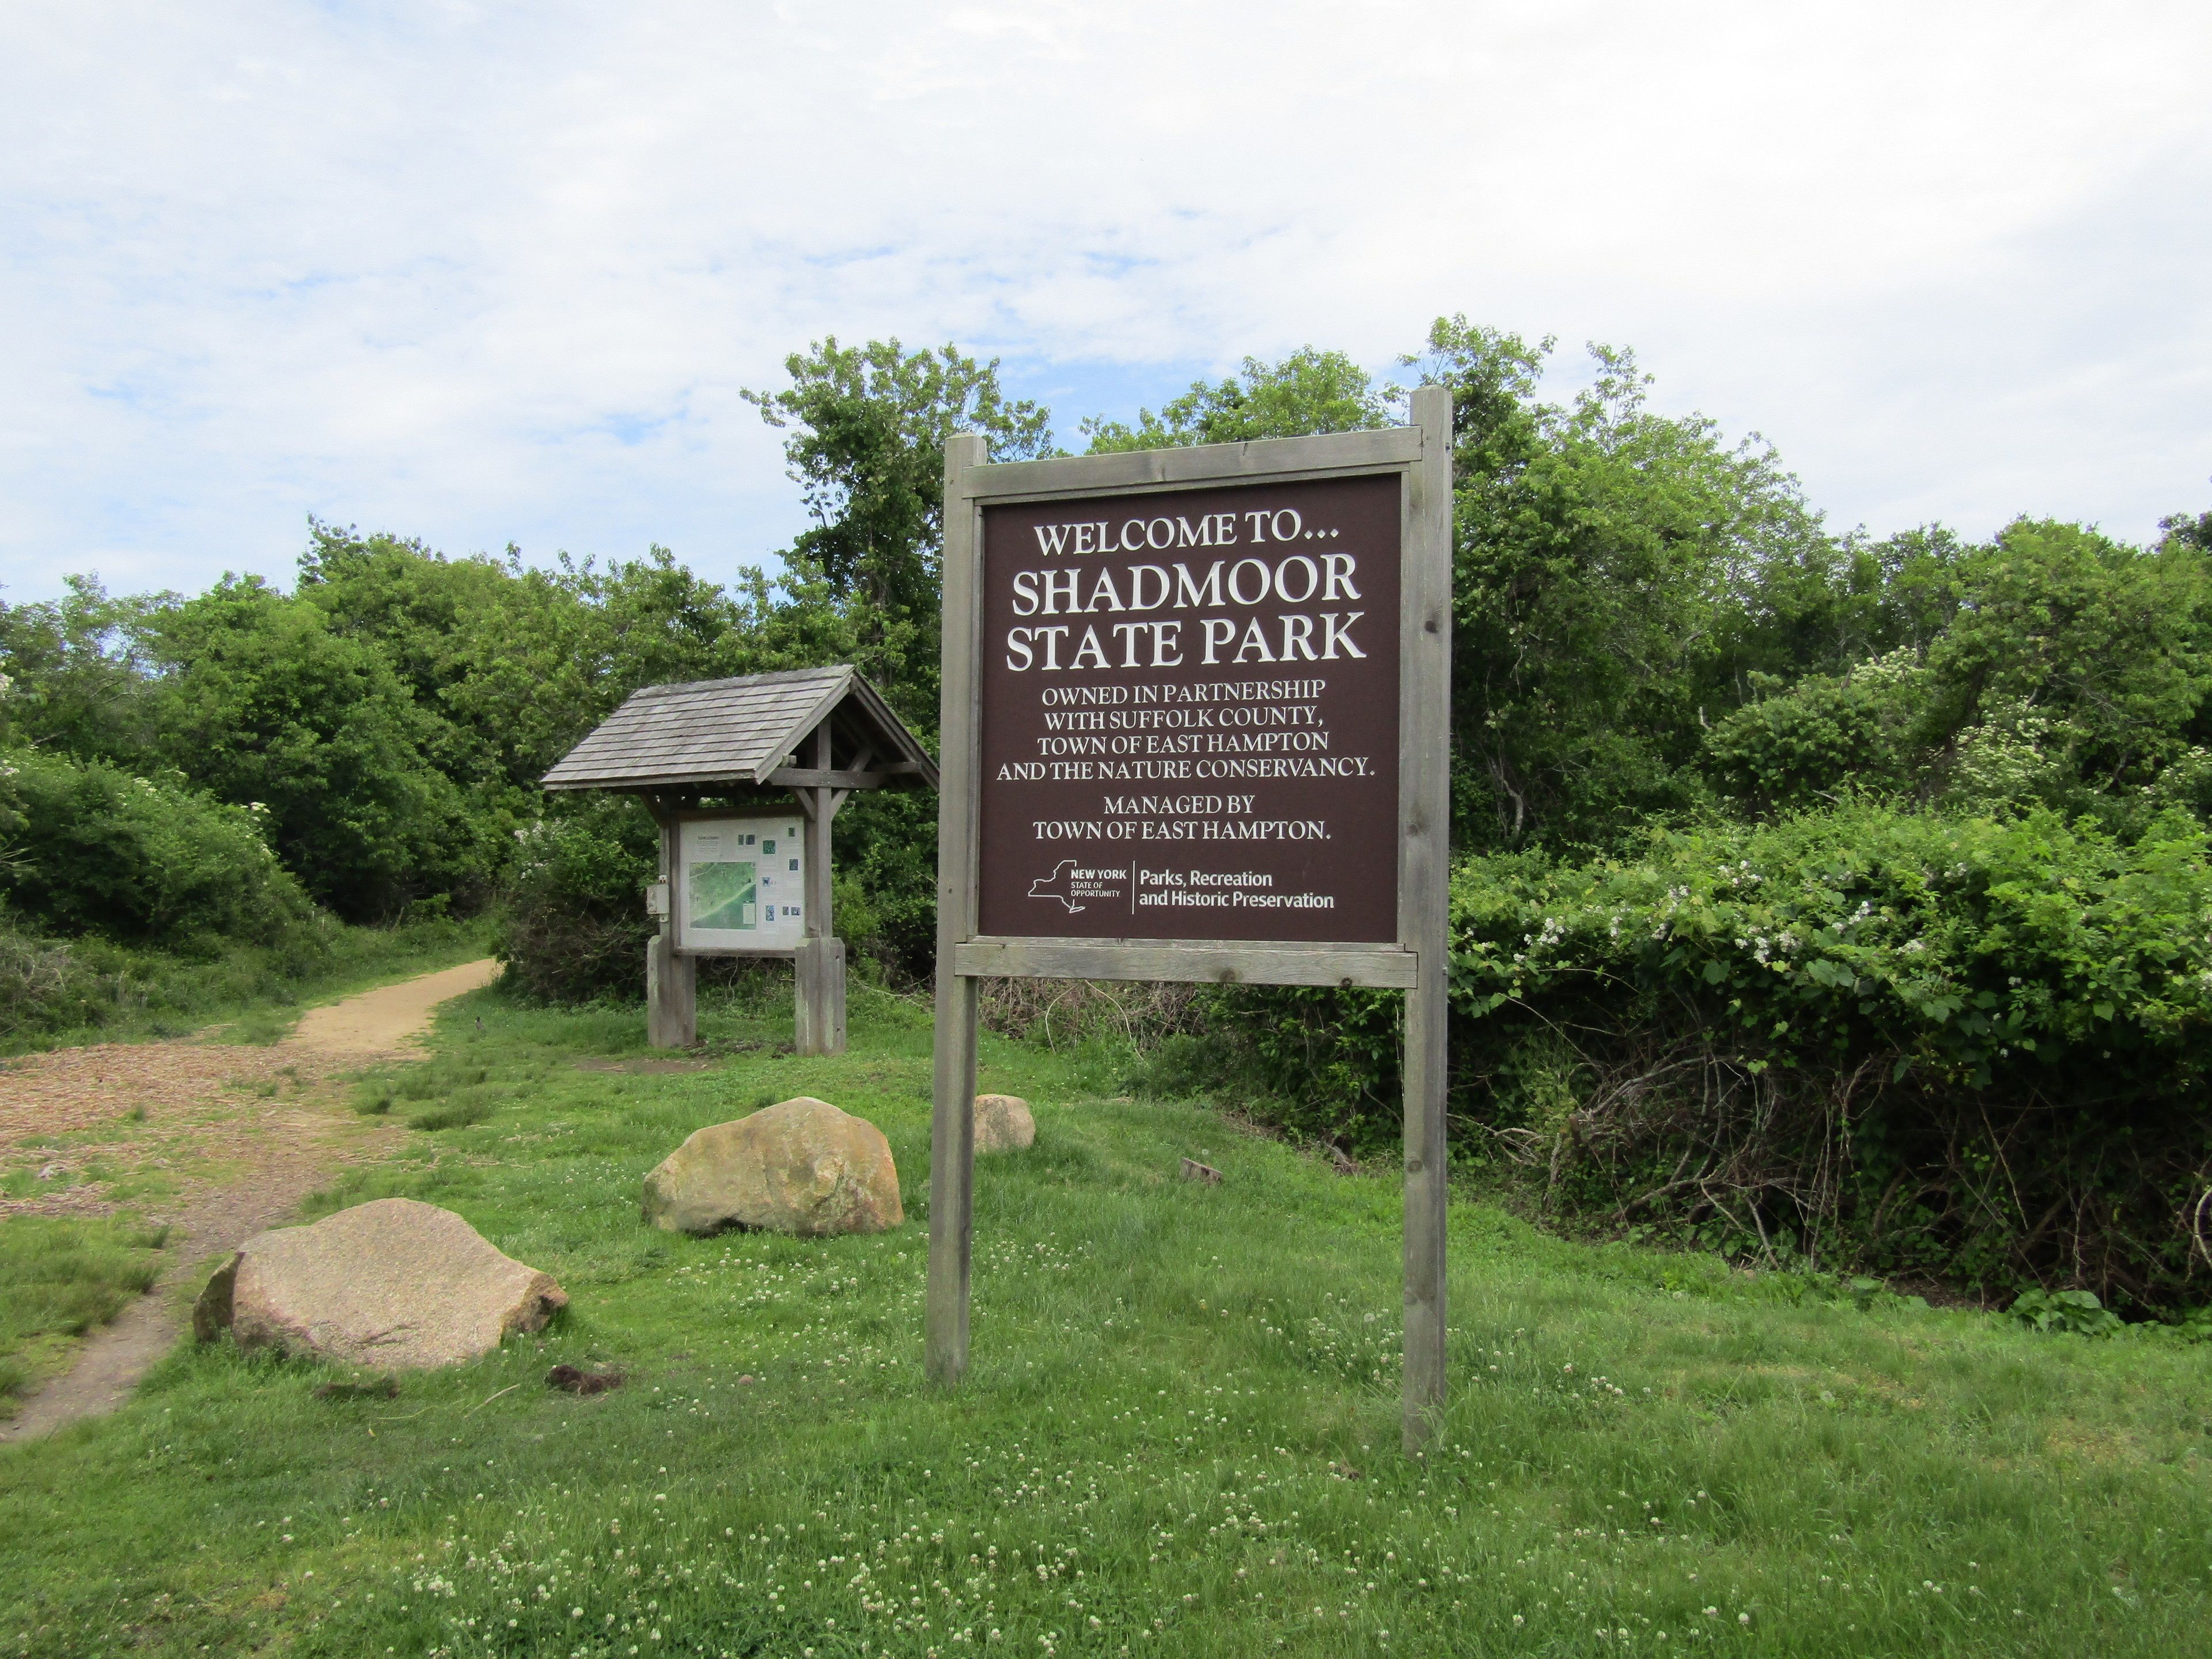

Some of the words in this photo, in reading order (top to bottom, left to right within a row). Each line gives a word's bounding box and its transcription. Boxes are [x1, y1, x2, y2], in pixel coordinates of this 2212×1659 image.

[1033, 513, 1237, 556] WELCOME
[1244, 508, 1339, 543] TO...
[1012, 553, 1362, 616] SHADMOOR
[1006, 620, 1183, 672] STATE
[1199, 611, 1368, 665] PARK
[1041, 686, 1128, 706] OWNED
[1132, 684, 1158, 704] IN
[1162, 679, 1326, 703] PARTNERSHIP
[1044, 711, 1106, 731] WITH
[1109, 708, 1214, 729] SUFFOLK
[1218, 705, 1323, 728] COUNTY,
[1037, 736, 1107, 755] TOWN
[1111, 736, 1142, 755] OF
[1146, 734, 1203, 754] EAST
[1206, 731, 1330, 752] HAMPTON
[996, 762, 1046, 781] AND
[1049, 761, 1094, 780] THE
[1097, 760, 1192, 779] NATURE
[1196, 756, 1376, 778] CONSERVANCY.
[1103, 795, 1222, 815] MANAGED
[1226, 794, 1256, 814] BY
[1032, 821, 1103, 839] TOWN
[1107, 821, 1138, 839] OF
[1141, 820, 1199, 840] EAST
[1202, 820, 1331, 840] HAMPTON.
[1070, 869, 1096, 880] NEW
[1096, 869, 1127, 880] YORK
[1071, 881, 1092, 889] STATE
[1140, 869, 1187, 888] Parks,
[1190, 869, 1272, 887] Recreation
[1070, 889, 1120, 897] OPPORTUNITY
[1139, 889, 1168, 906] and
[1171, 890, 1230, 907] Historic
[1233, 891, 1335, 908] Preservation
